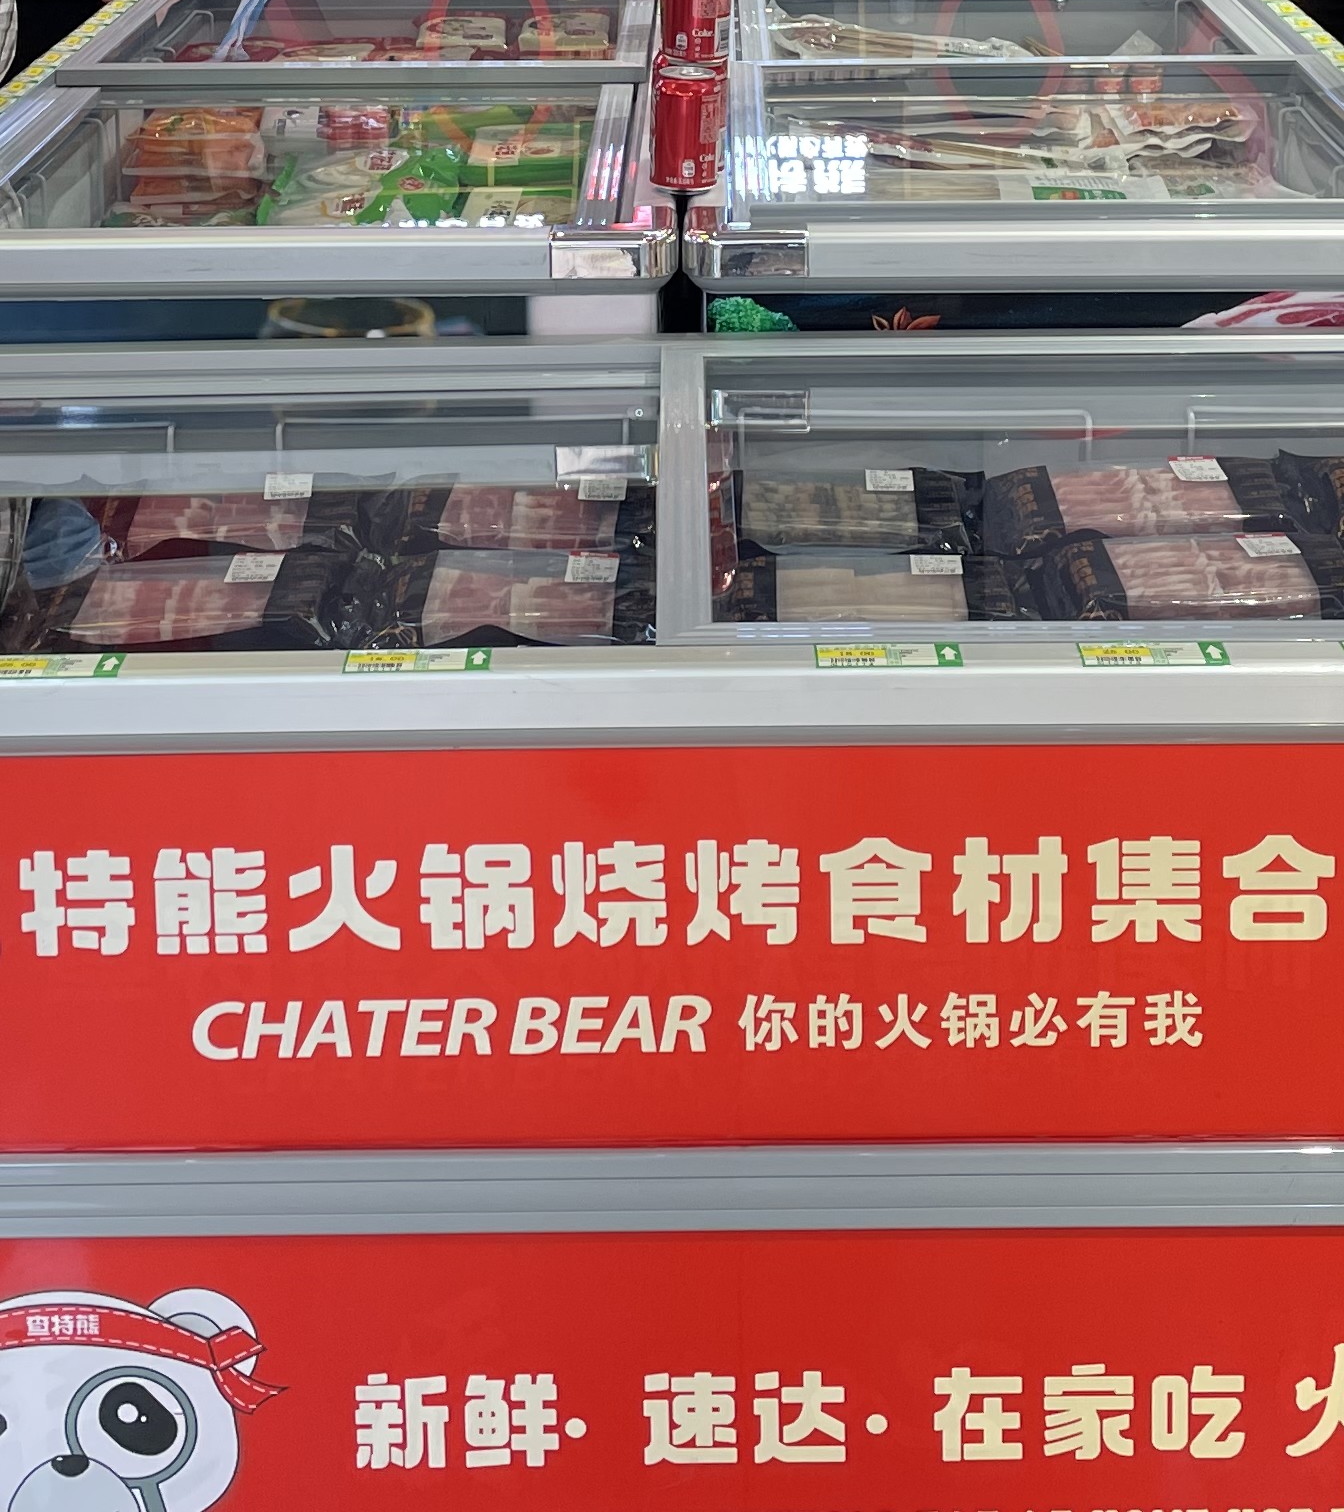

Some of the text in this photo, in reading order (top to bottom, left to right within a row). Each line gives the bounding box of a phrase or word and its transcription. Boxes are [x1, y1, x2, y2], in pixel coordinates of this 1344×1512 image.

[192, 994, 713, 1061] CHATER BEAR
[737, 990, 1204, 1052] 你的火锅必有我
[23, 1312, 101, 1339] 查特熊
